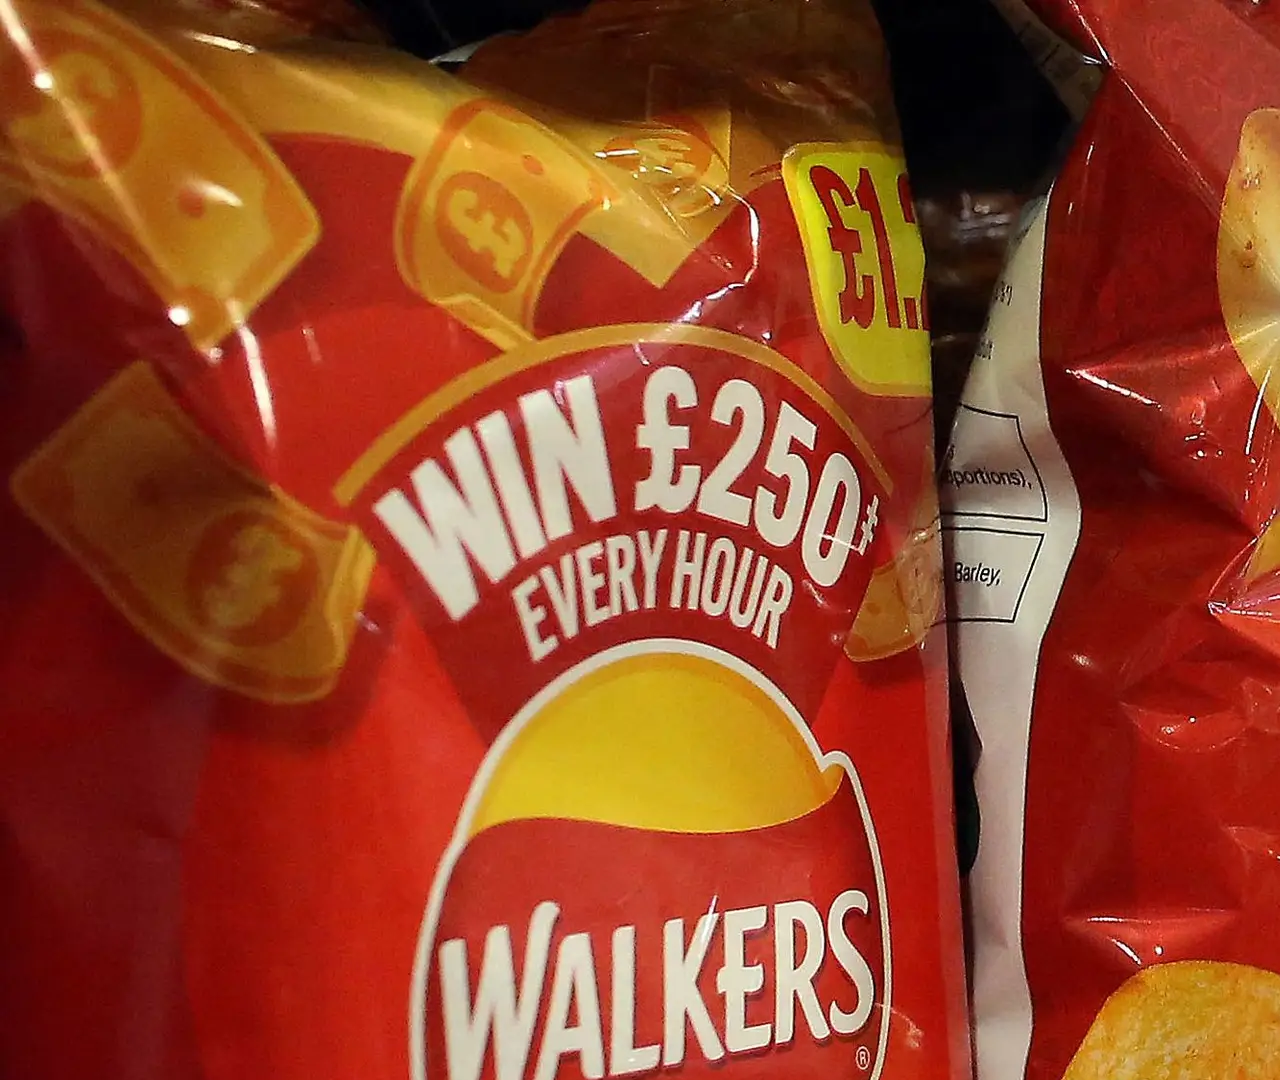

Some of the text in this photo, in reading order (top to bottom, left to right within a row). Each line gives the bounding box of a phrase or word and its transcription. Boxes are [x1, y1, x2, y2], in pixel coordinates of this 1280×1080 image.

[373, 375, 617, 621] WIN
[512, 529, 793, 663] EVERY HOUR
[954, 562, 1001, 586] Barley,
